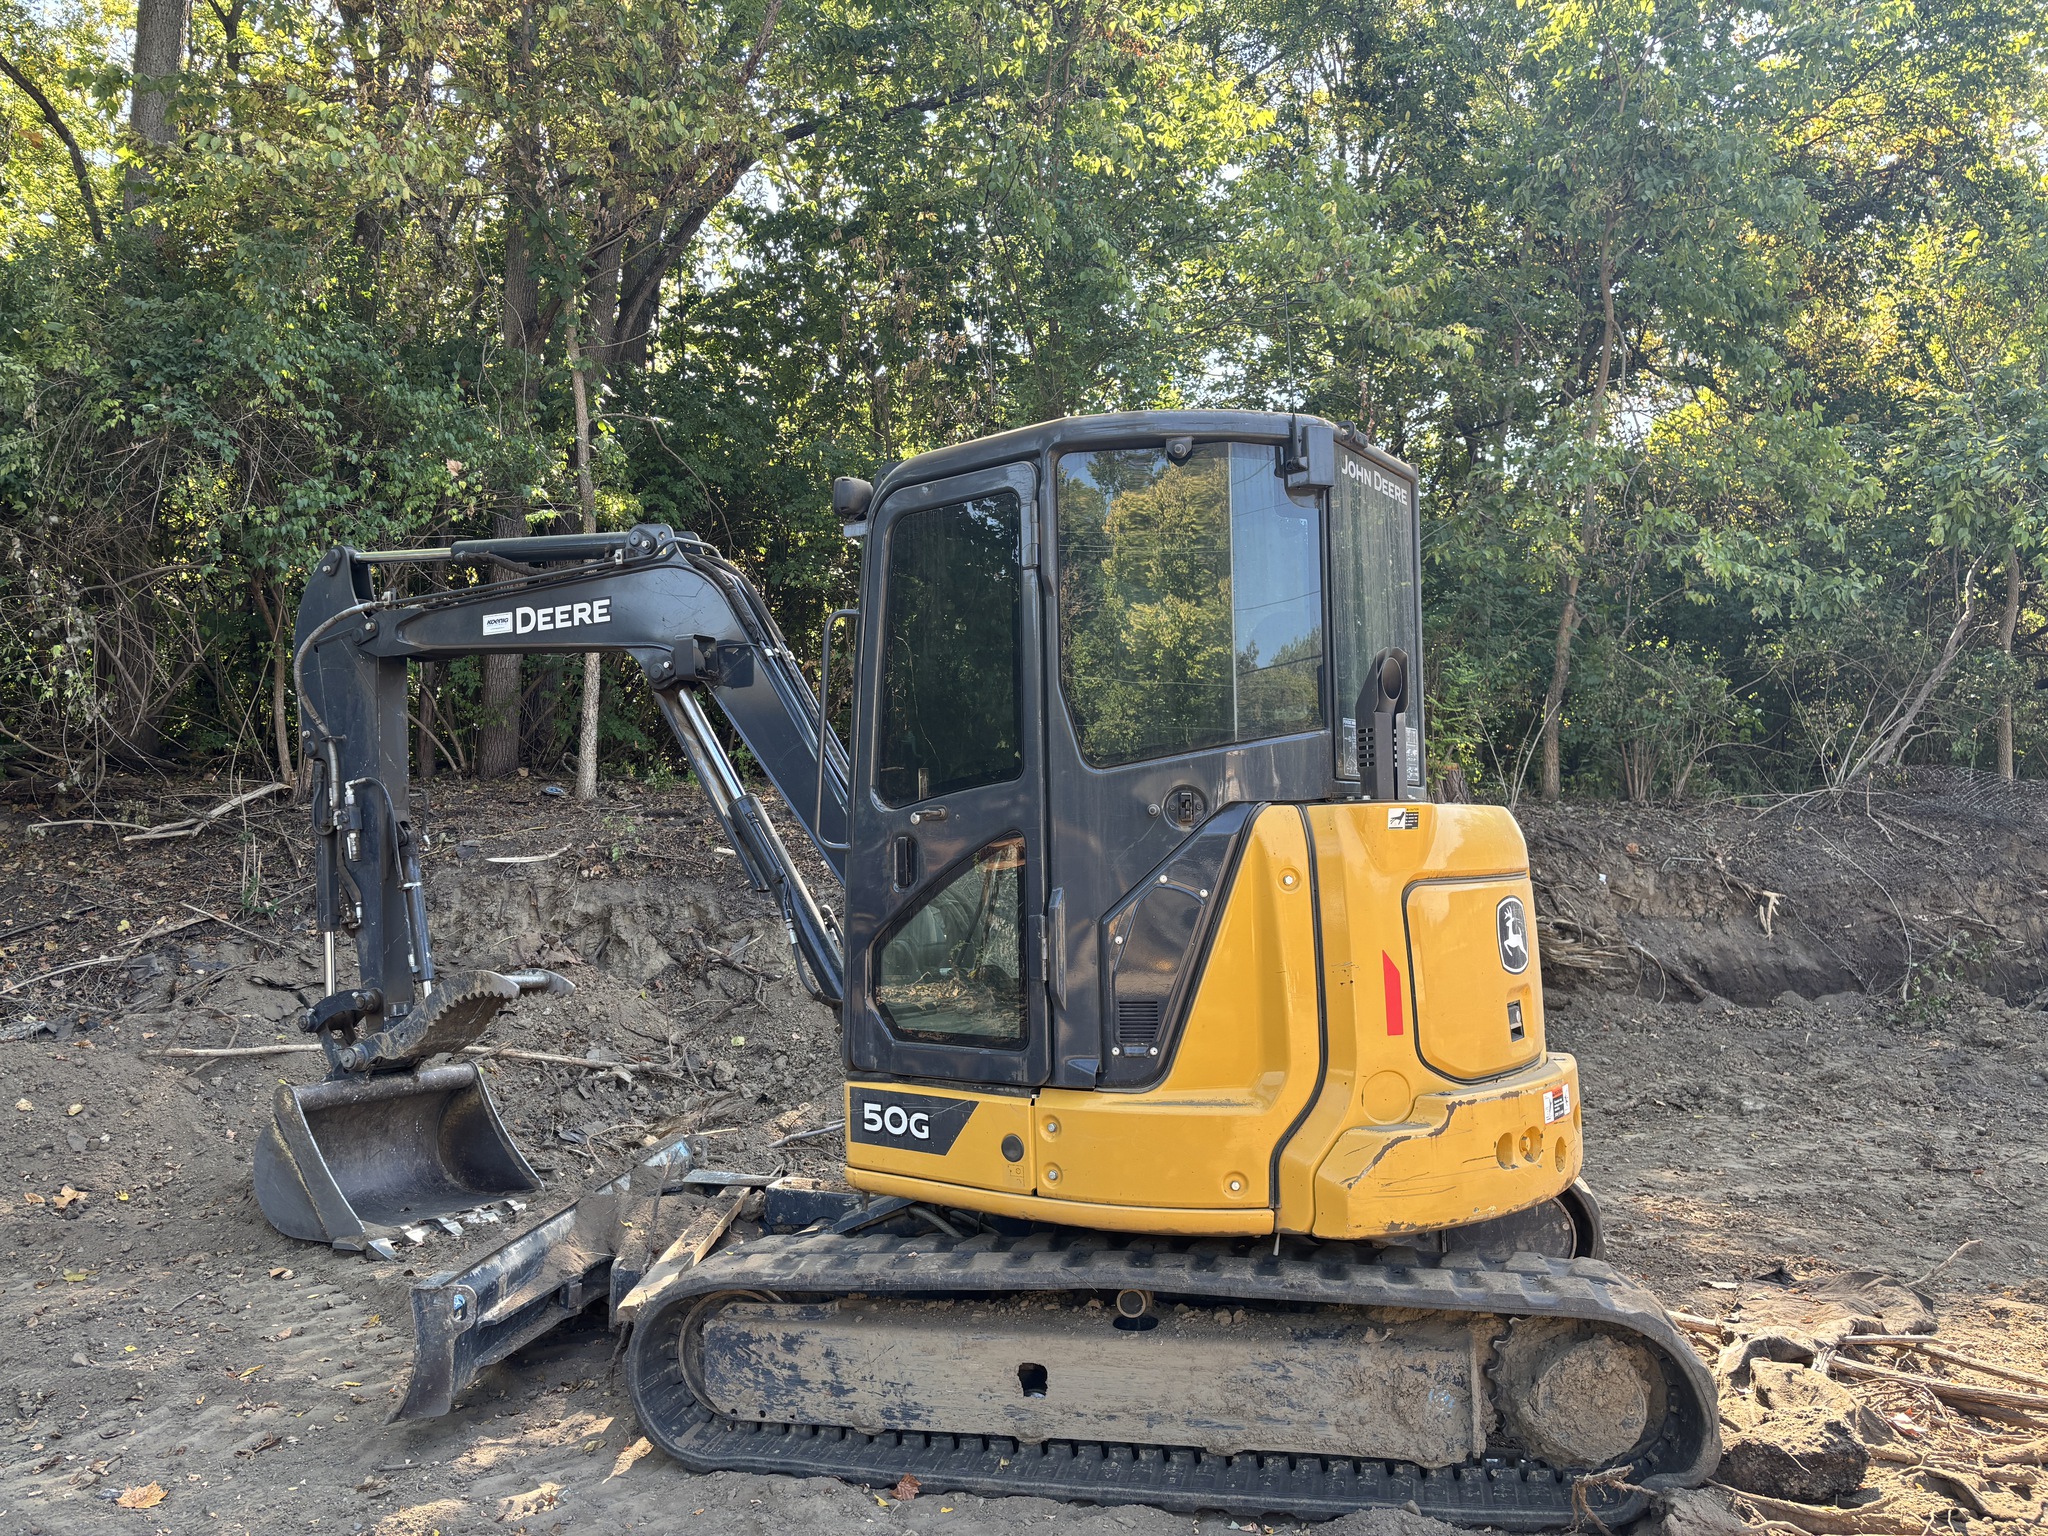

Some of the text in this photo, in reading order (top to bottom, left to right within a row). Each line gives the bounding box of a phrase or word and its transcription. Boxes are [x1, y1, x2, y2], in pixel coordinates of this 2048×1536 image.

[1341, 454, 1408, 506] JOHN DEERE
[516, 599, 611, 634] DEERE
[863, 1102, 929, 1139] 50G
